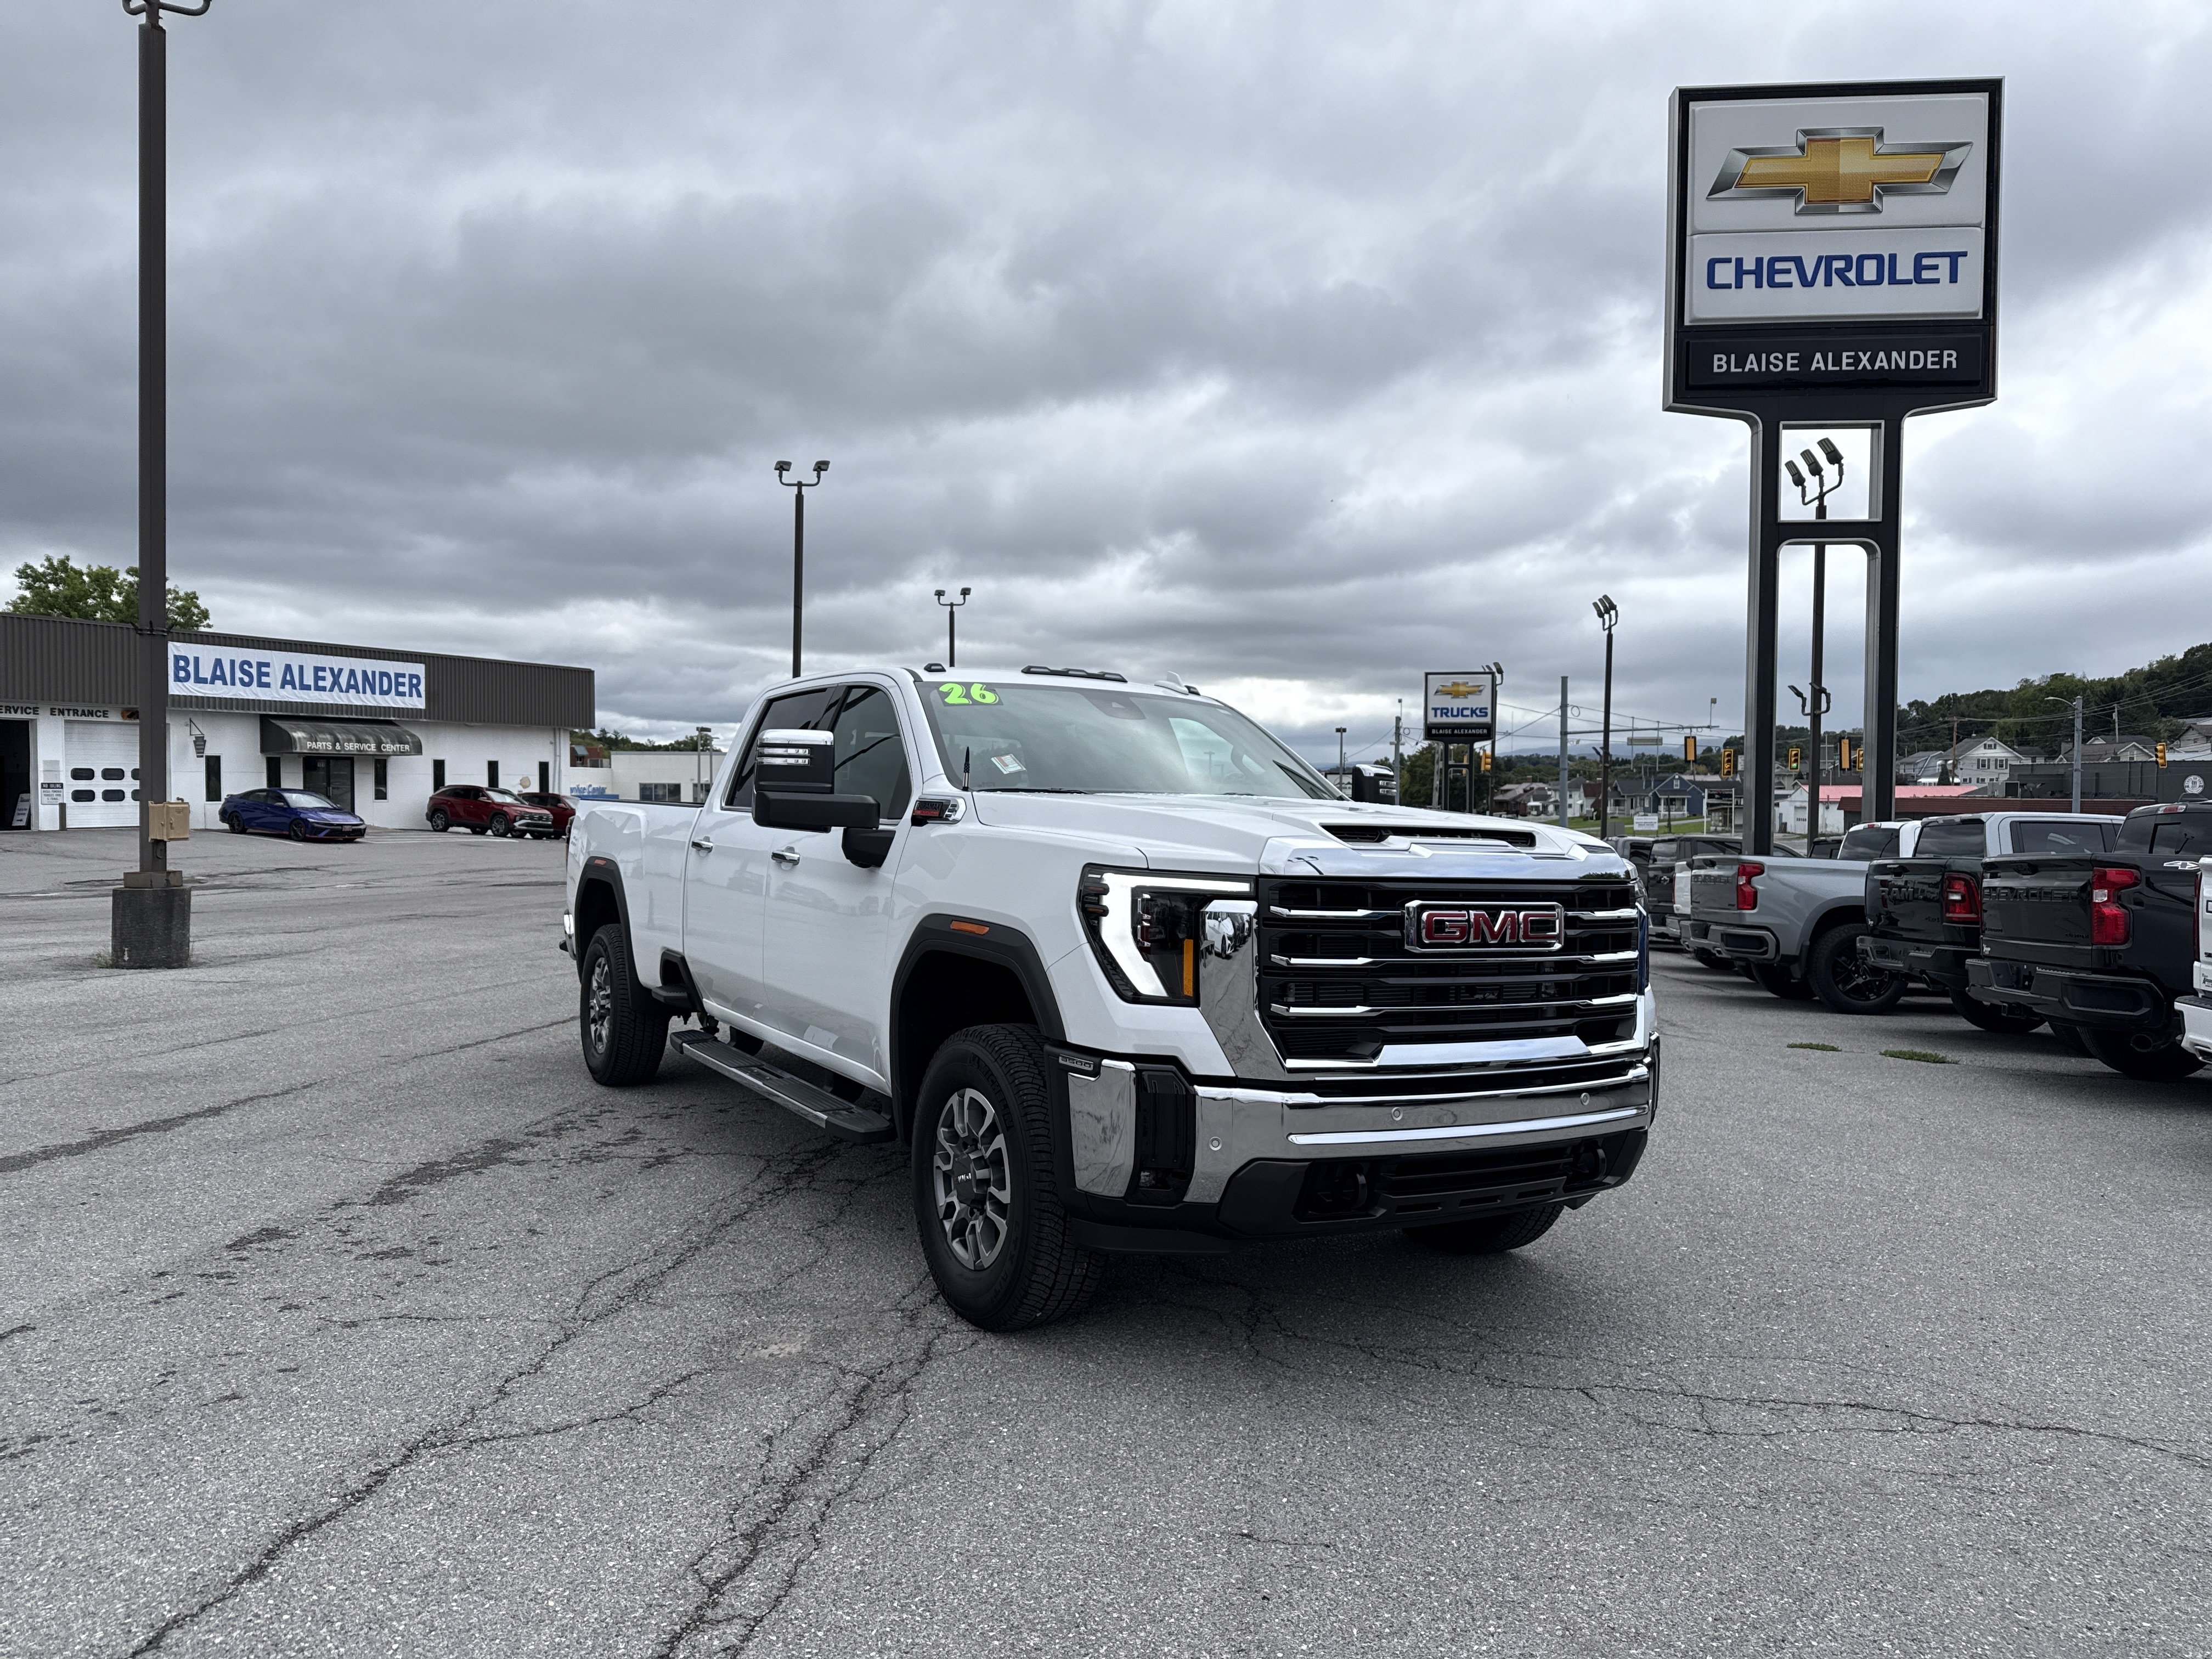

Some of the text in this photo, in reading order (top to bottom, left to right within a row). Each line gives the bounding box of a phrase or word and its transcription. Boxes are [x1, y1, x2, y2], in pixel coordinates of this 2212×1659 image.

[1707, 251, 1968, 290] CHEVROLET
[1713, 350, 1958, 373] BLAISE ALEXANDER
[173, 654, 422, 698] BLAISE ALEXANDER
[939, 682, 999, 704] 26
[49, 707, 110, 718] ENTRANCE
[1431, 707, 1488, 718] TRUCKS
[307, 742, 332, 750] PARTS
[344, 743, 376, 752] SERVICE
[381, 744, 410, 752] CENTER
[916, 802, 941, 810] DURAMAX
[1880, 888, 1914, 901] RAM
[1982, 887, 2079, 902] CHEVROLET
[1421, 909, 1559, 944] GMC
